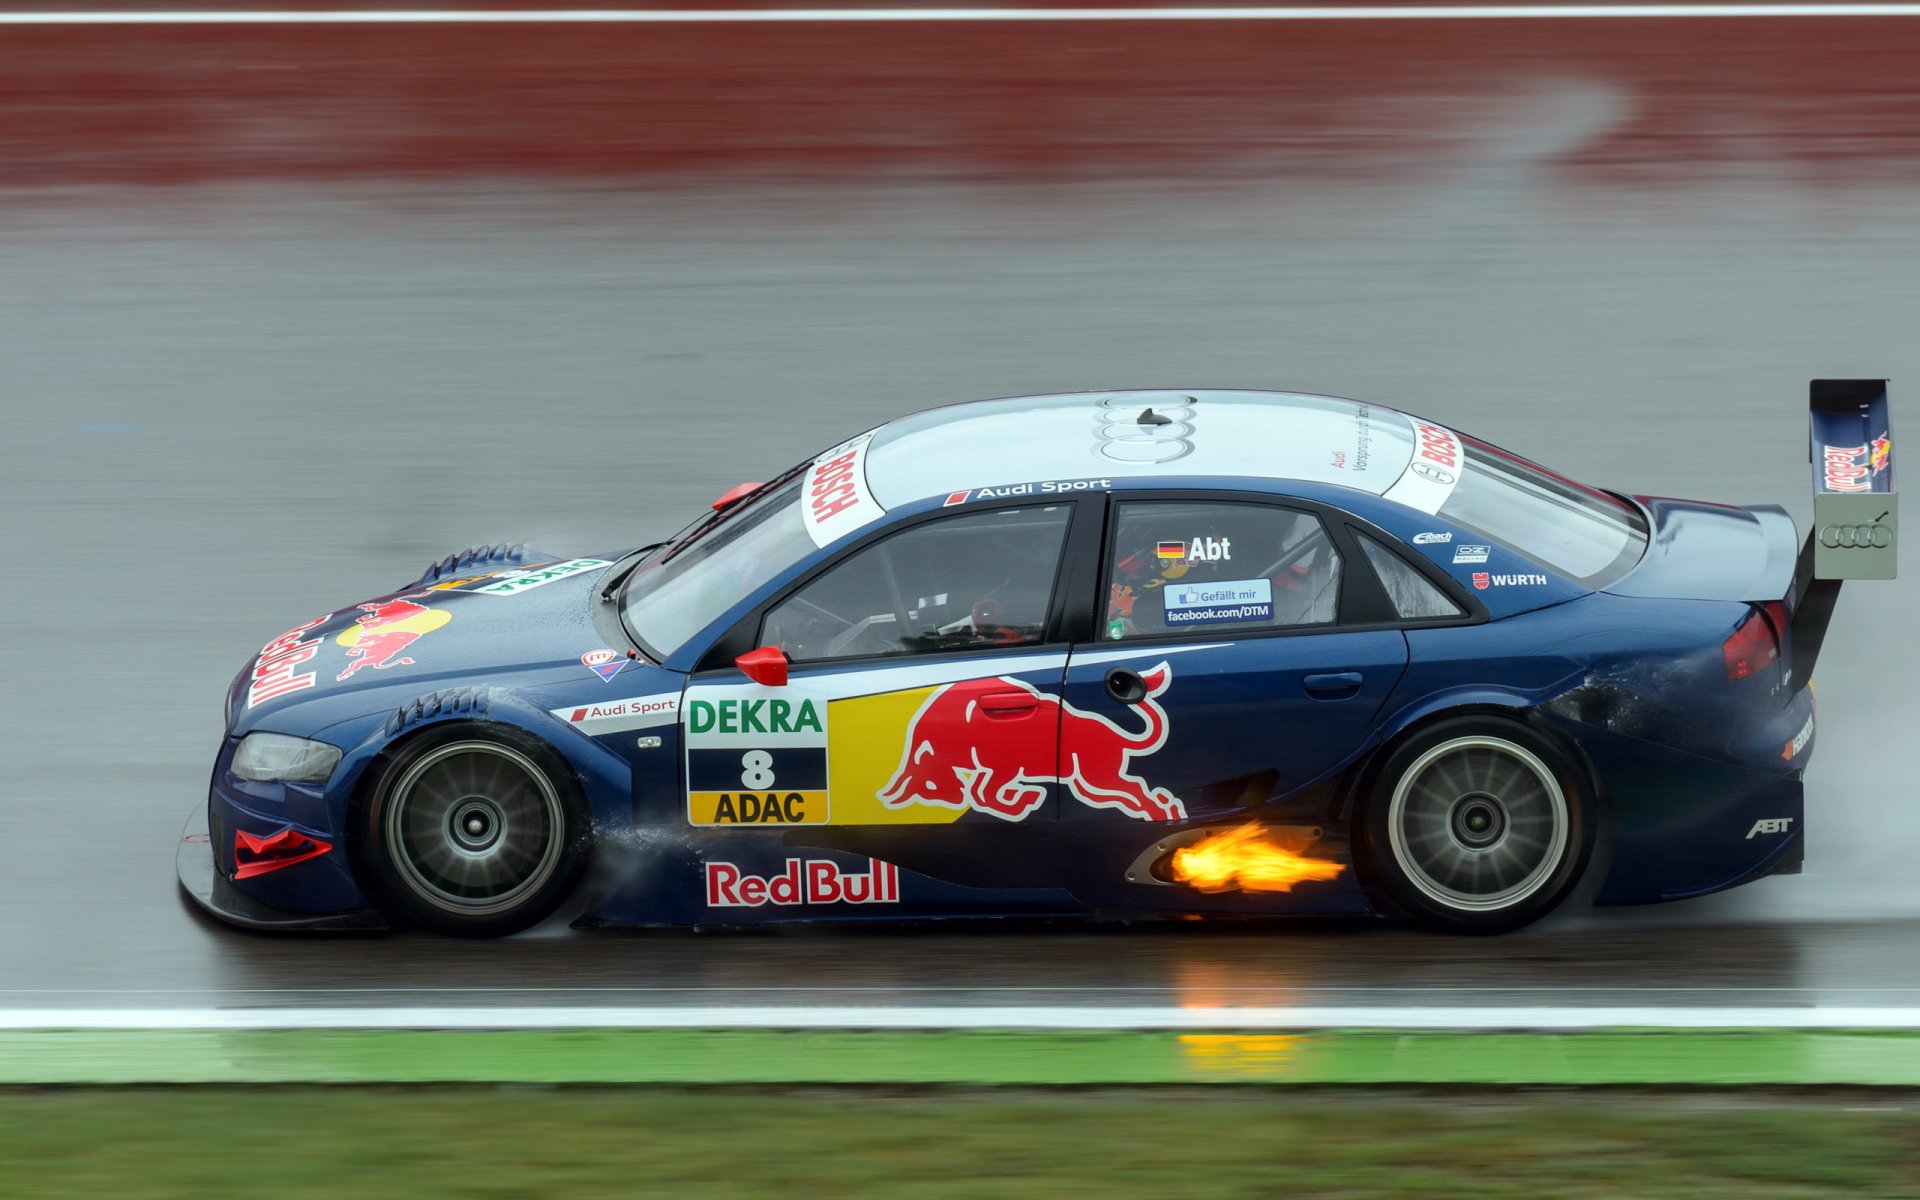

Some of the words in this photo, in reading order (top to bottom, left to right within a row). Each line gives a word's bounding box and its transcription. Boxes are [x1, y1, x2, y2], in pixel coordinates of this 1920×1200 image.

[1353, 436, 1373, 471] Vorsprung
[1415, 420, 1457, 468] BOSCH
[1331, 451, 1345, 469] Audi
[811, 450, 860, 524] BOSCH
[977, 483, 1033, 499] Audi
[1041, 479, 1111, 494] Sport
[1188, 537, 1231, 561] Abt
[1413, 531, 1453, 544] Eibach
[486, 559, 605, 592] DEKRA
[1491, 574, 1547, 586] WÜRTH
[1201, 589, 1236, 602] Gefällt
[1239, 589, 1257, 600] mir
[1167, 605, 1269, 622] facebook.com/DTM
[247, 646, 318, 709] Bull
[590, 704, 627, 718] Audi
[631, 700, 676, 715] Sport
[690, 698, 823, 733] DEKRA
[741, 750, 775, 790] 8
[714, 793, 805, 823] ADAC
[1746, 817, 1794, 839] ABT
[707, 858, 802, 906] Red
[806, 858, 899, 903] Bull
